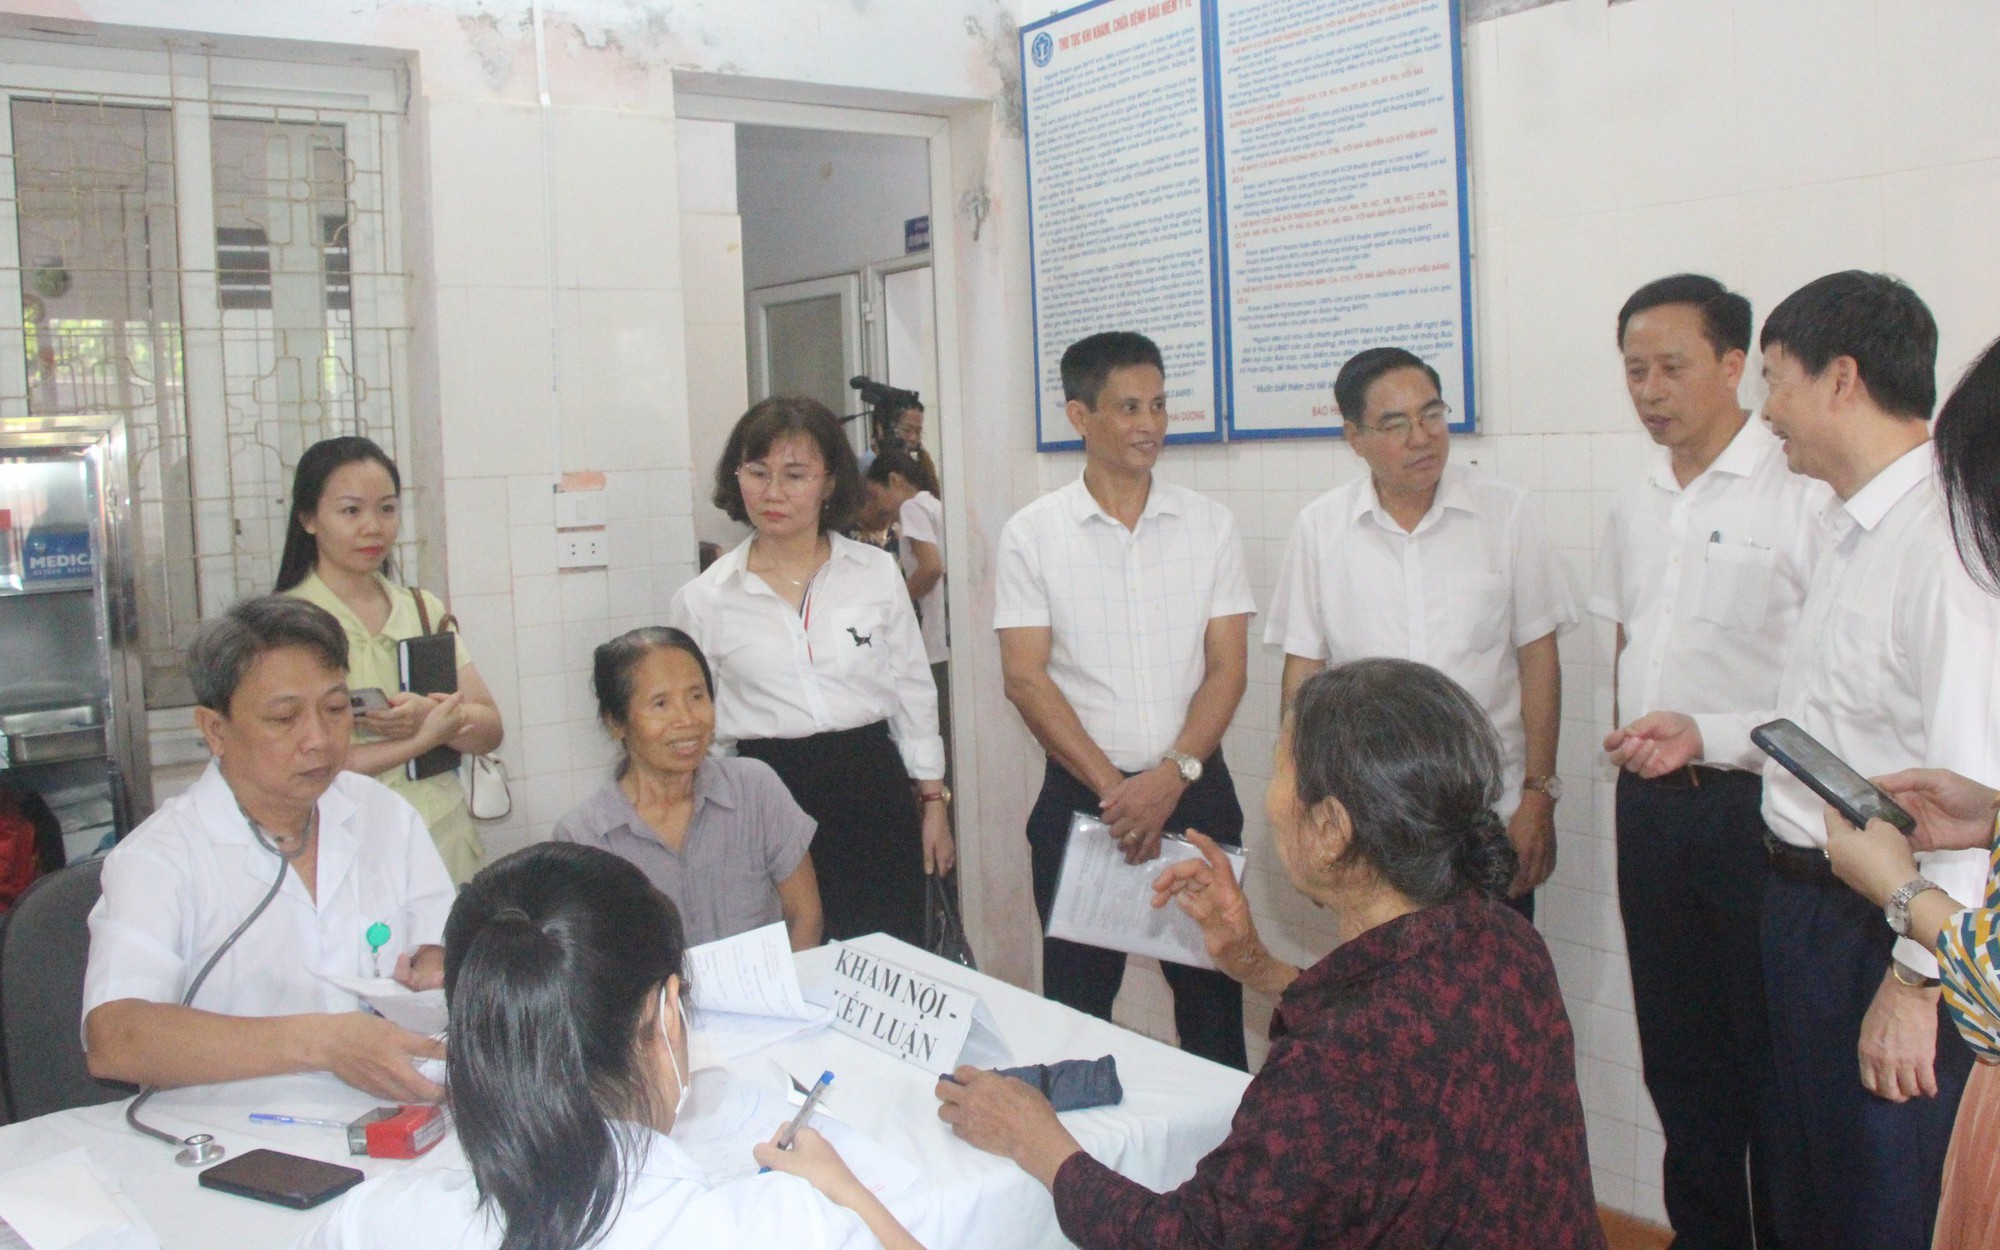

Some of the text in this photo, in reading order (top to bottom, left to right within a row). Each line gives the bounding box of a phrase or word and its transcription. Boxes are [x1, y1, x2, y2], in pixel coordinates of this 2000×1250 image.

[1082, 29, 1092, 43] KHI
[834, 949, 902, 998] KHÁM
[902, 978, 948, 1020] NỘI
[872, 1011, 938, 1062] LUẬN
